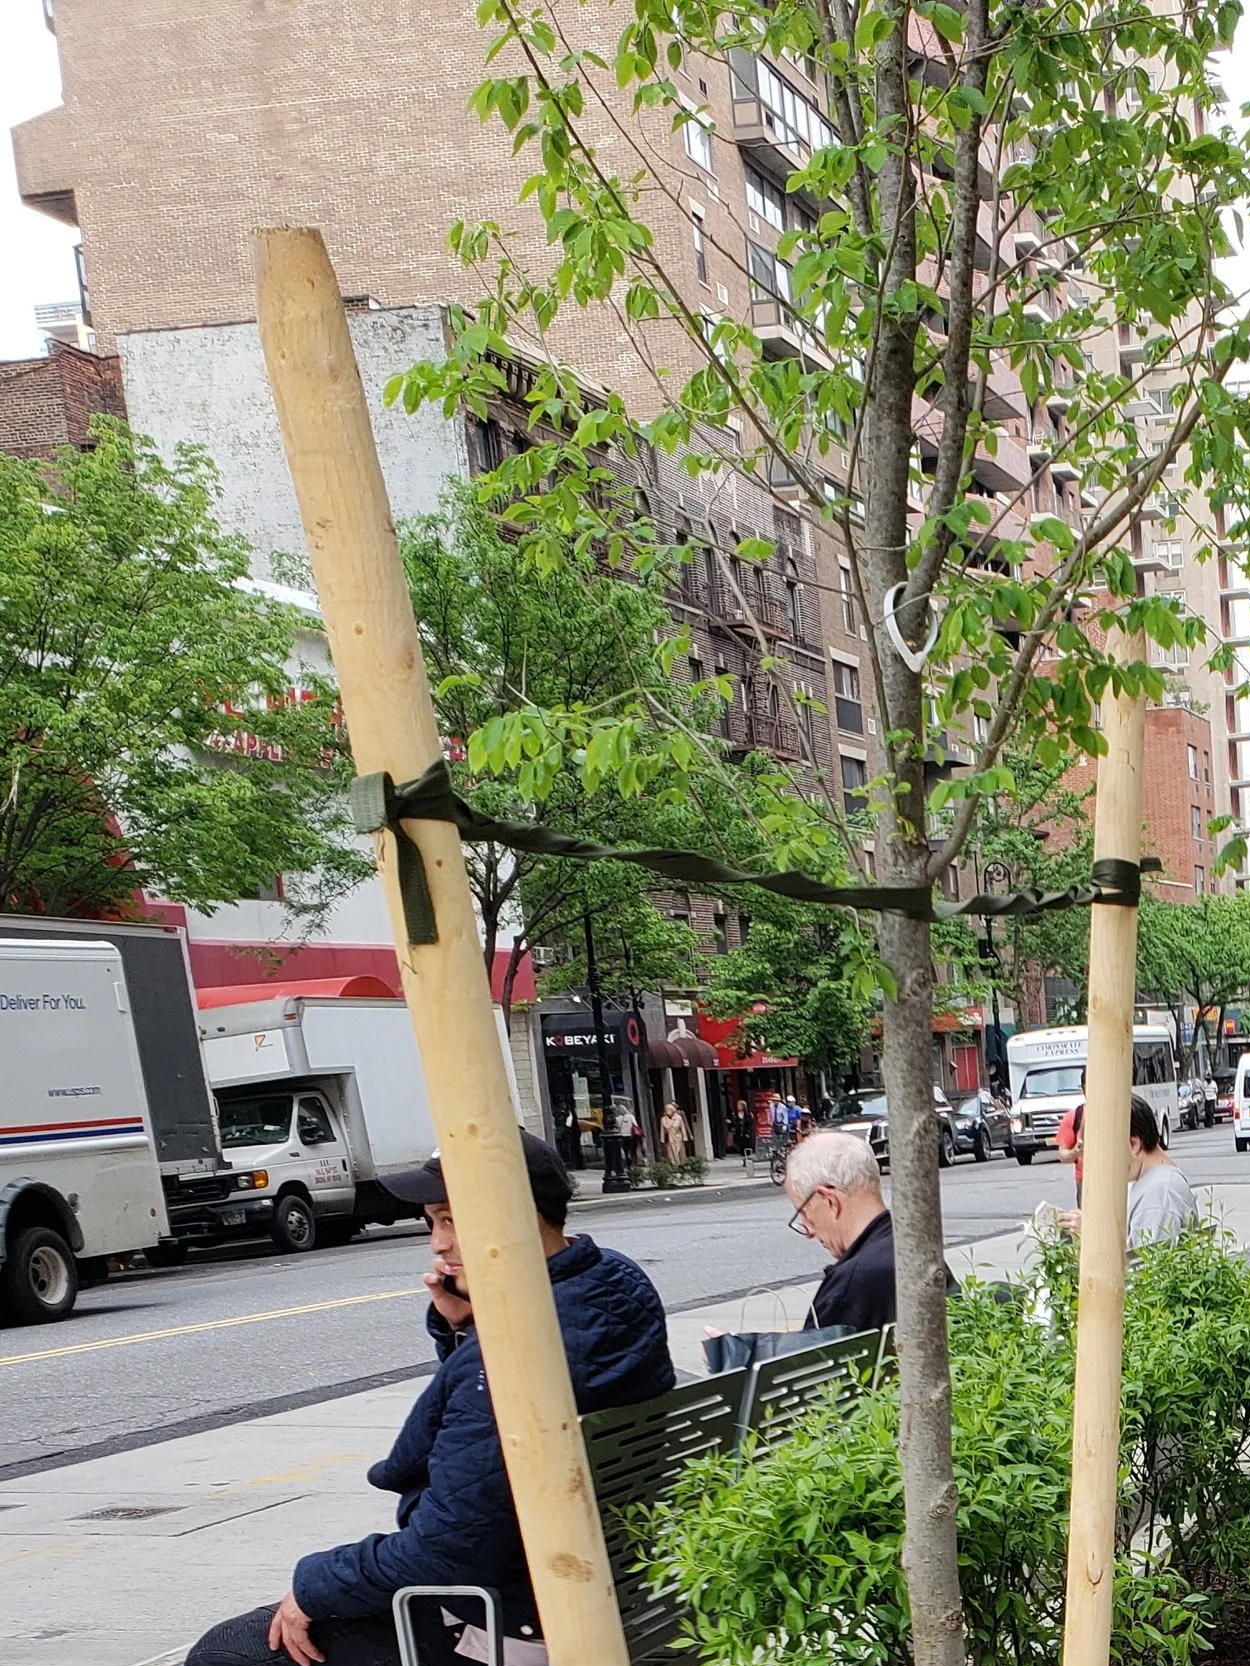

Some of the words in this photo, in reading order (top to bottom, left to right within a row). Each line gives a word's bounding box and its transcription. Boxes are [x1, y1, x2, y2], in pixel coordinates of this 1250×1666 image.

[0, 994, 40, 1010] Deliver
[42, 994, 61, 1010] For
[1044, 1048, 1079, 1057] EXPRESS
